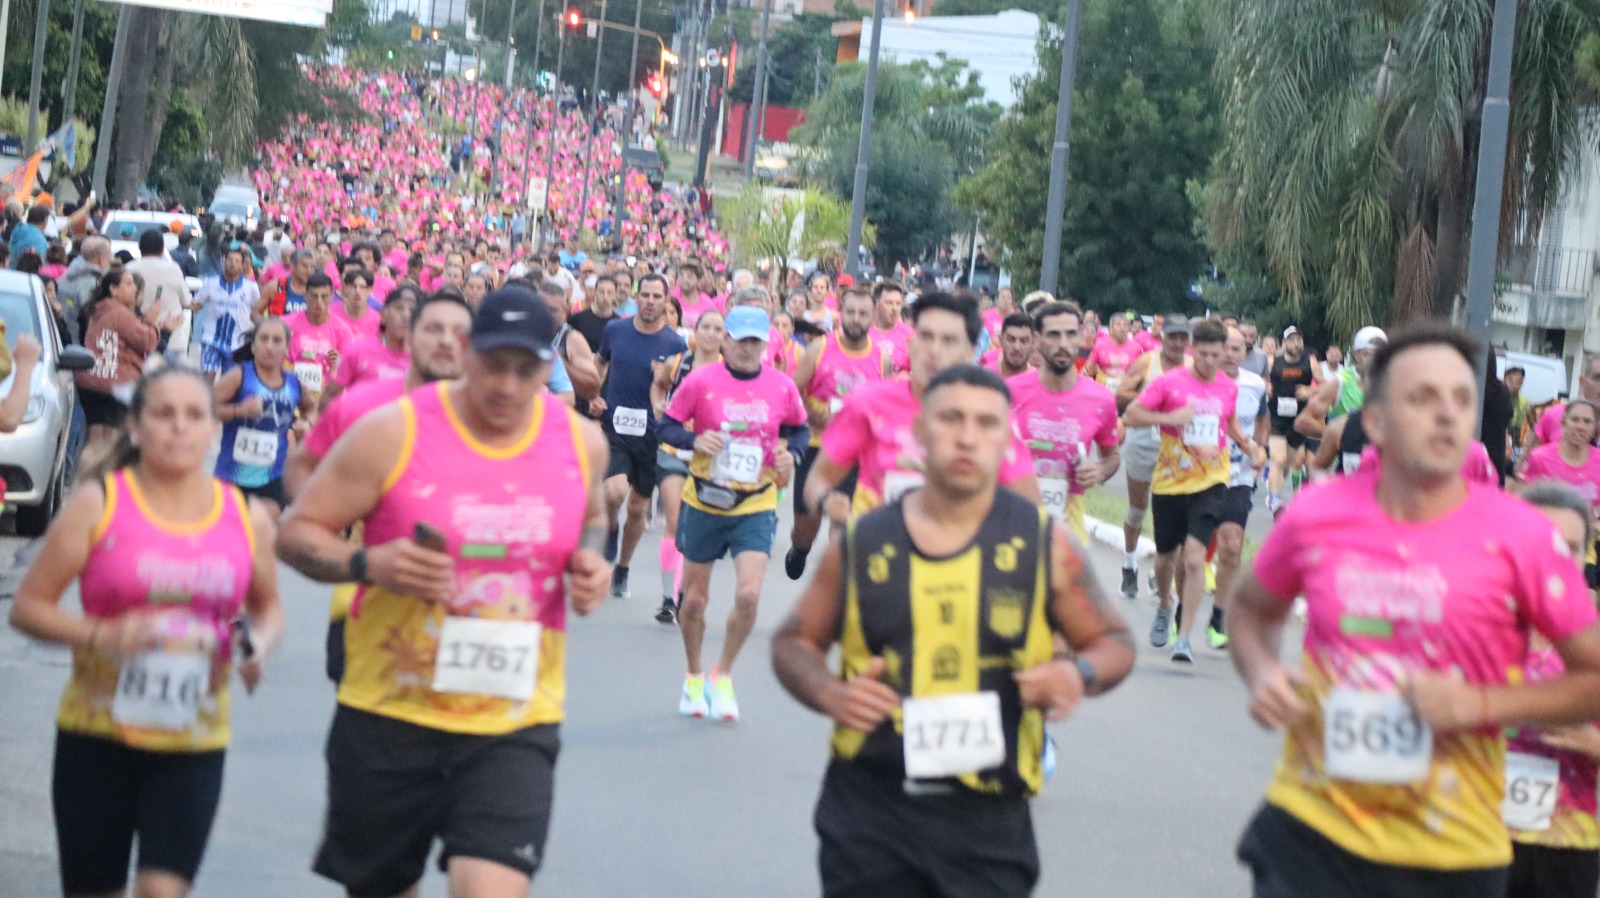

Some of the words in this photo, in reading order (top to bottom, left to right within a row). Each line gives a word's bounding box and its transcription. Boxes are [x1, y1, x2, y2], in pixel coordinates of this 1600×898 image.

[614, 415, 645, 429] 1225
[236, 436, 273, 458] 412
[719, 452, 758, 472] 479
[1041, 490, 1064, 506] 50
[446, 641, 531, 673] 1767
[122, 670, 201, 705] 816
[913, 719, 996, 751] 1771
[1332, 710, 1423, 759] 569
[1510, 777, 1554, 807] 67
